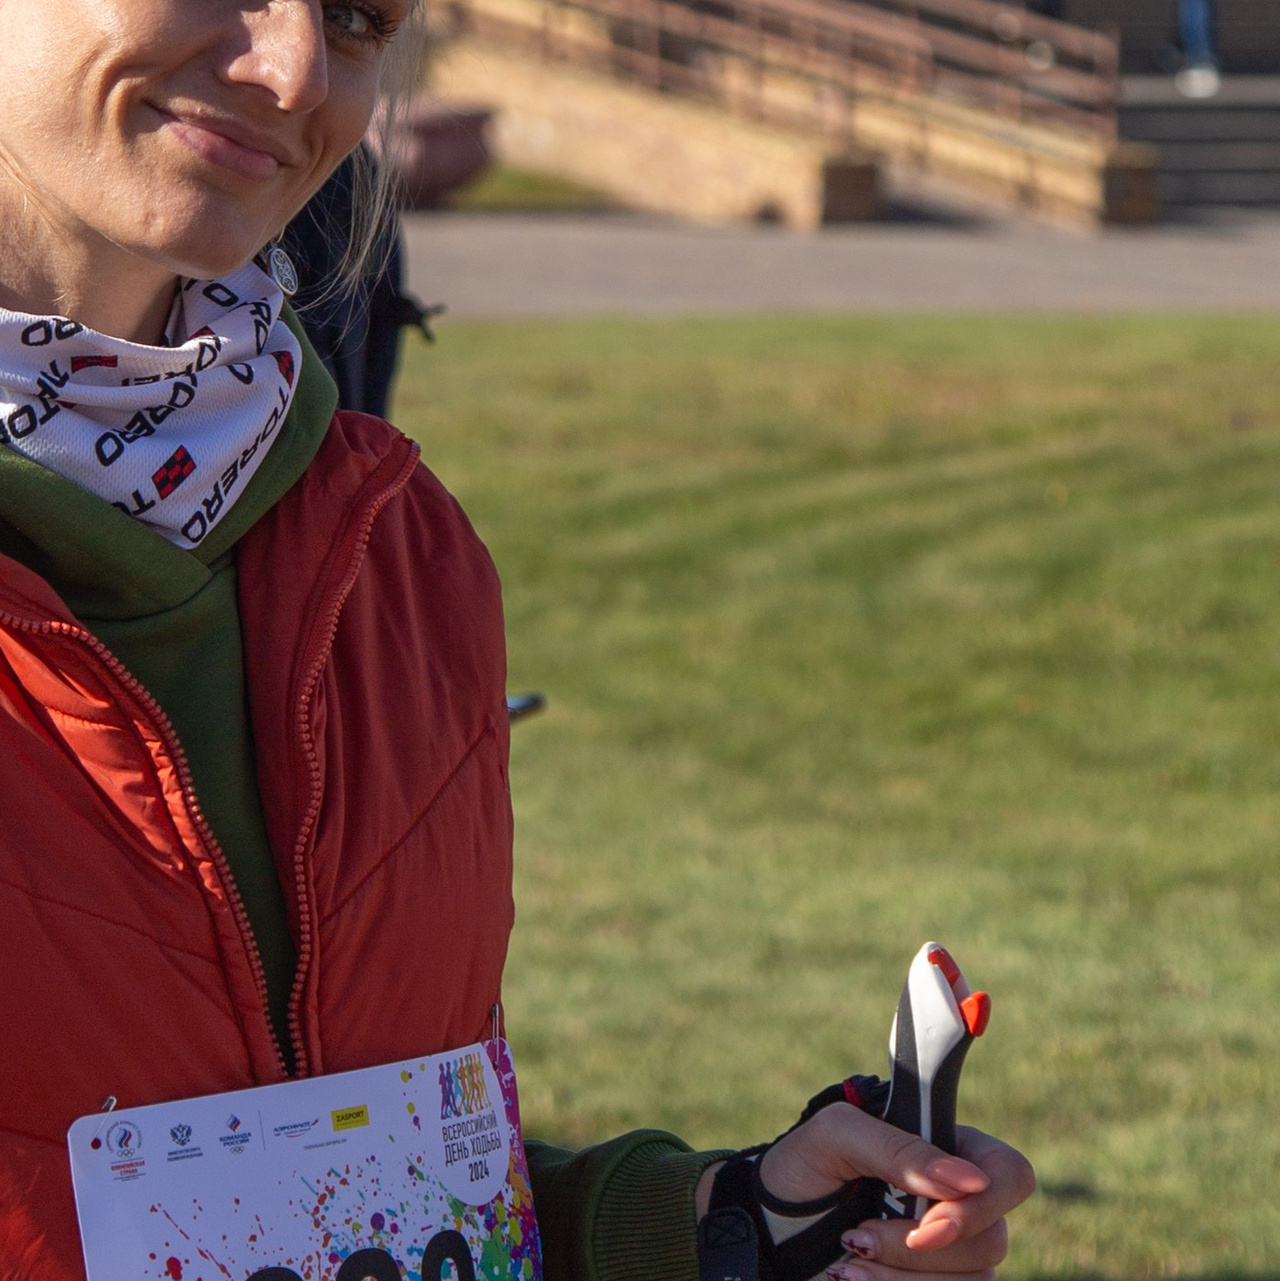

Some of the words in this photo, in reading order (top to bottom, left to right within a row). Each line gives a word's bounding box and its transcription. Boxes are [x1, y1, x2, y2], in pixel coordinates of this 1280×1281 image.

[336, 1110, 365, 1122] ZASPORT
[441, 1110, 499, 1142] ВСЕРОССИЙСКИЙ
[444, 1141, 470, 1167] ДЕНЬ
[470, 1130, 503, 1157] ХОДЬБЫ
[468, 1158, 490, 1183] 2024
